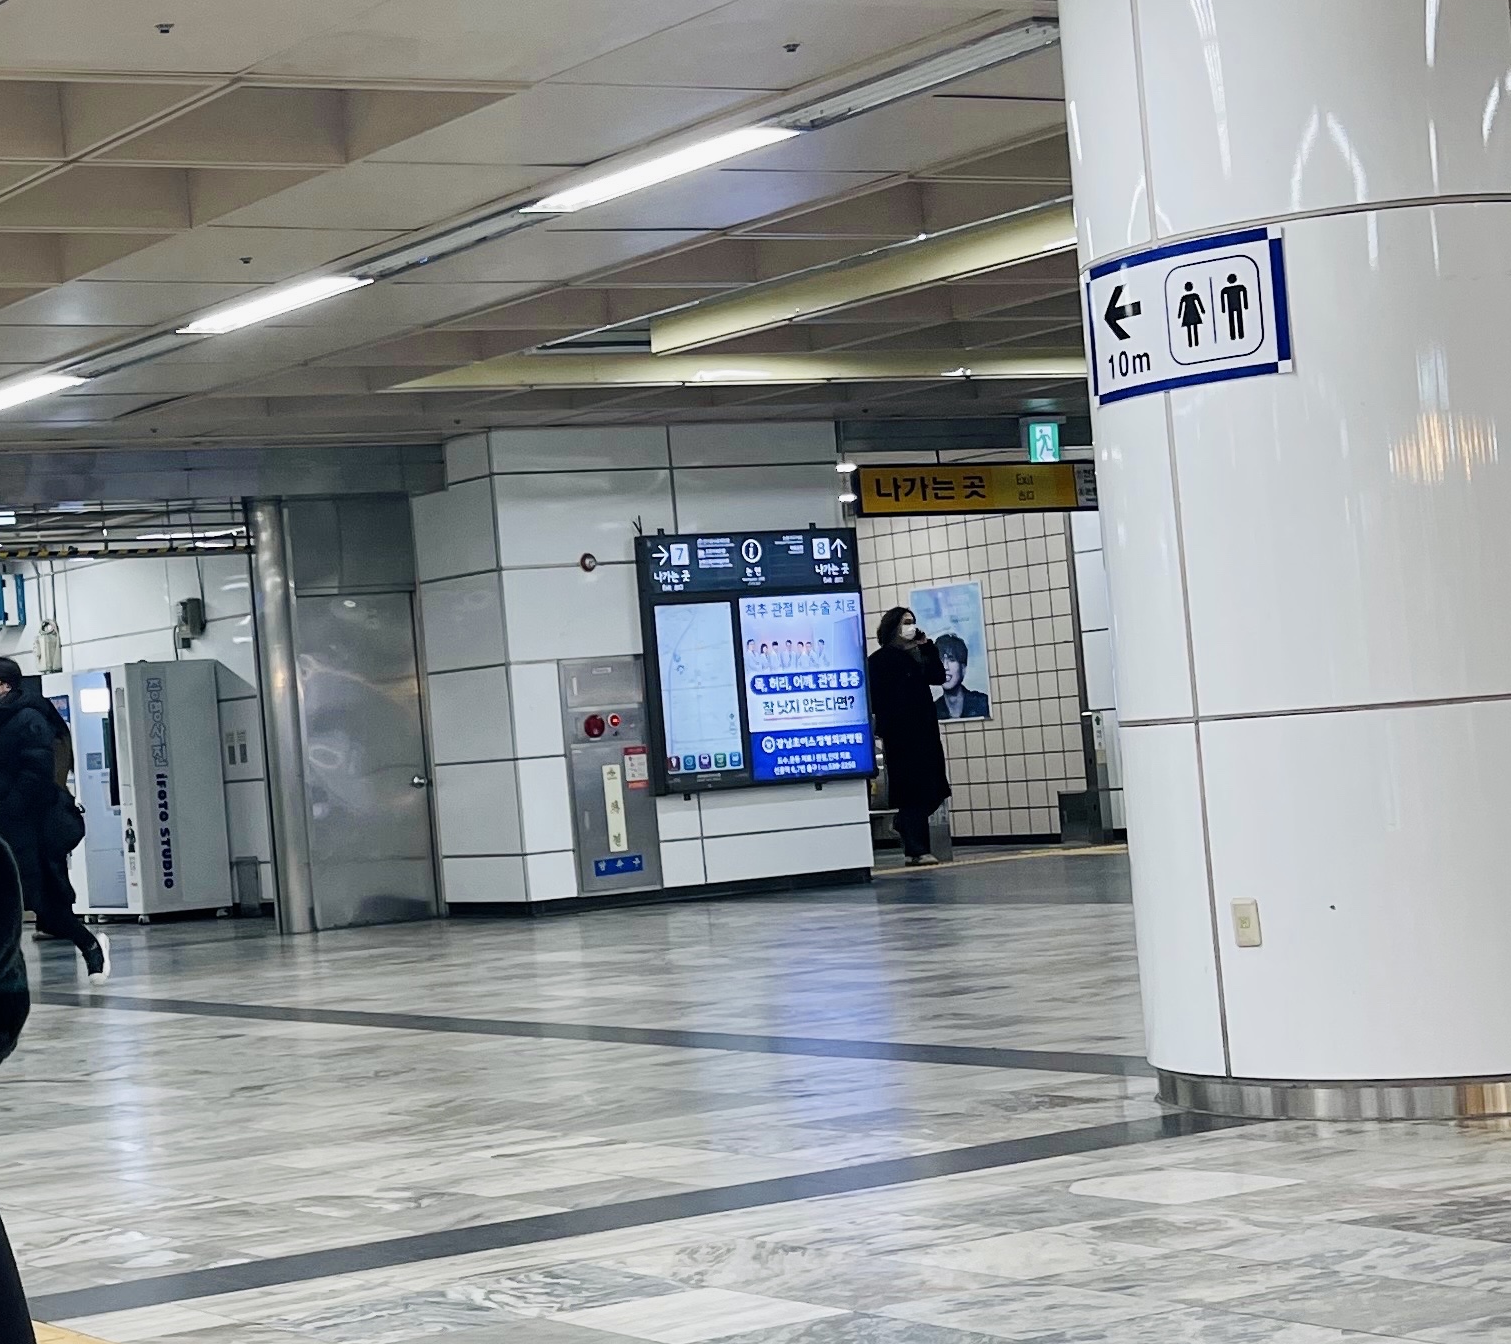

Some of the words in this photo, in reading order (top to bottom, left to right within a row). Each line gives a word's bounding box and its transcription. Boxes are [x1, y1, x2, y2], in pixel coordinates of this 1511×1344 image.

[1108, 350, 1151, 380] 10m
[875, 475, 955, 502] 나가는
[962, 475, 987, 500] 곳
[1015, 472, 1034, 486] Exit
[653, 570, 680, 584] 나가는
[815, 563, 840, 576] 나가는
[745, 603, 768, 619] 척추
[771, 601, 794, 618] 관절
[797, 600, 831, 617] 비수술
[835, 599, 857, 614] 치료
[763, 701, 775, 715] 잘
[777, 699, 800, 715] 낫지
[803, 696, 855, 713] 않는다면?
[160, 827, 174, 889] STUDIO
